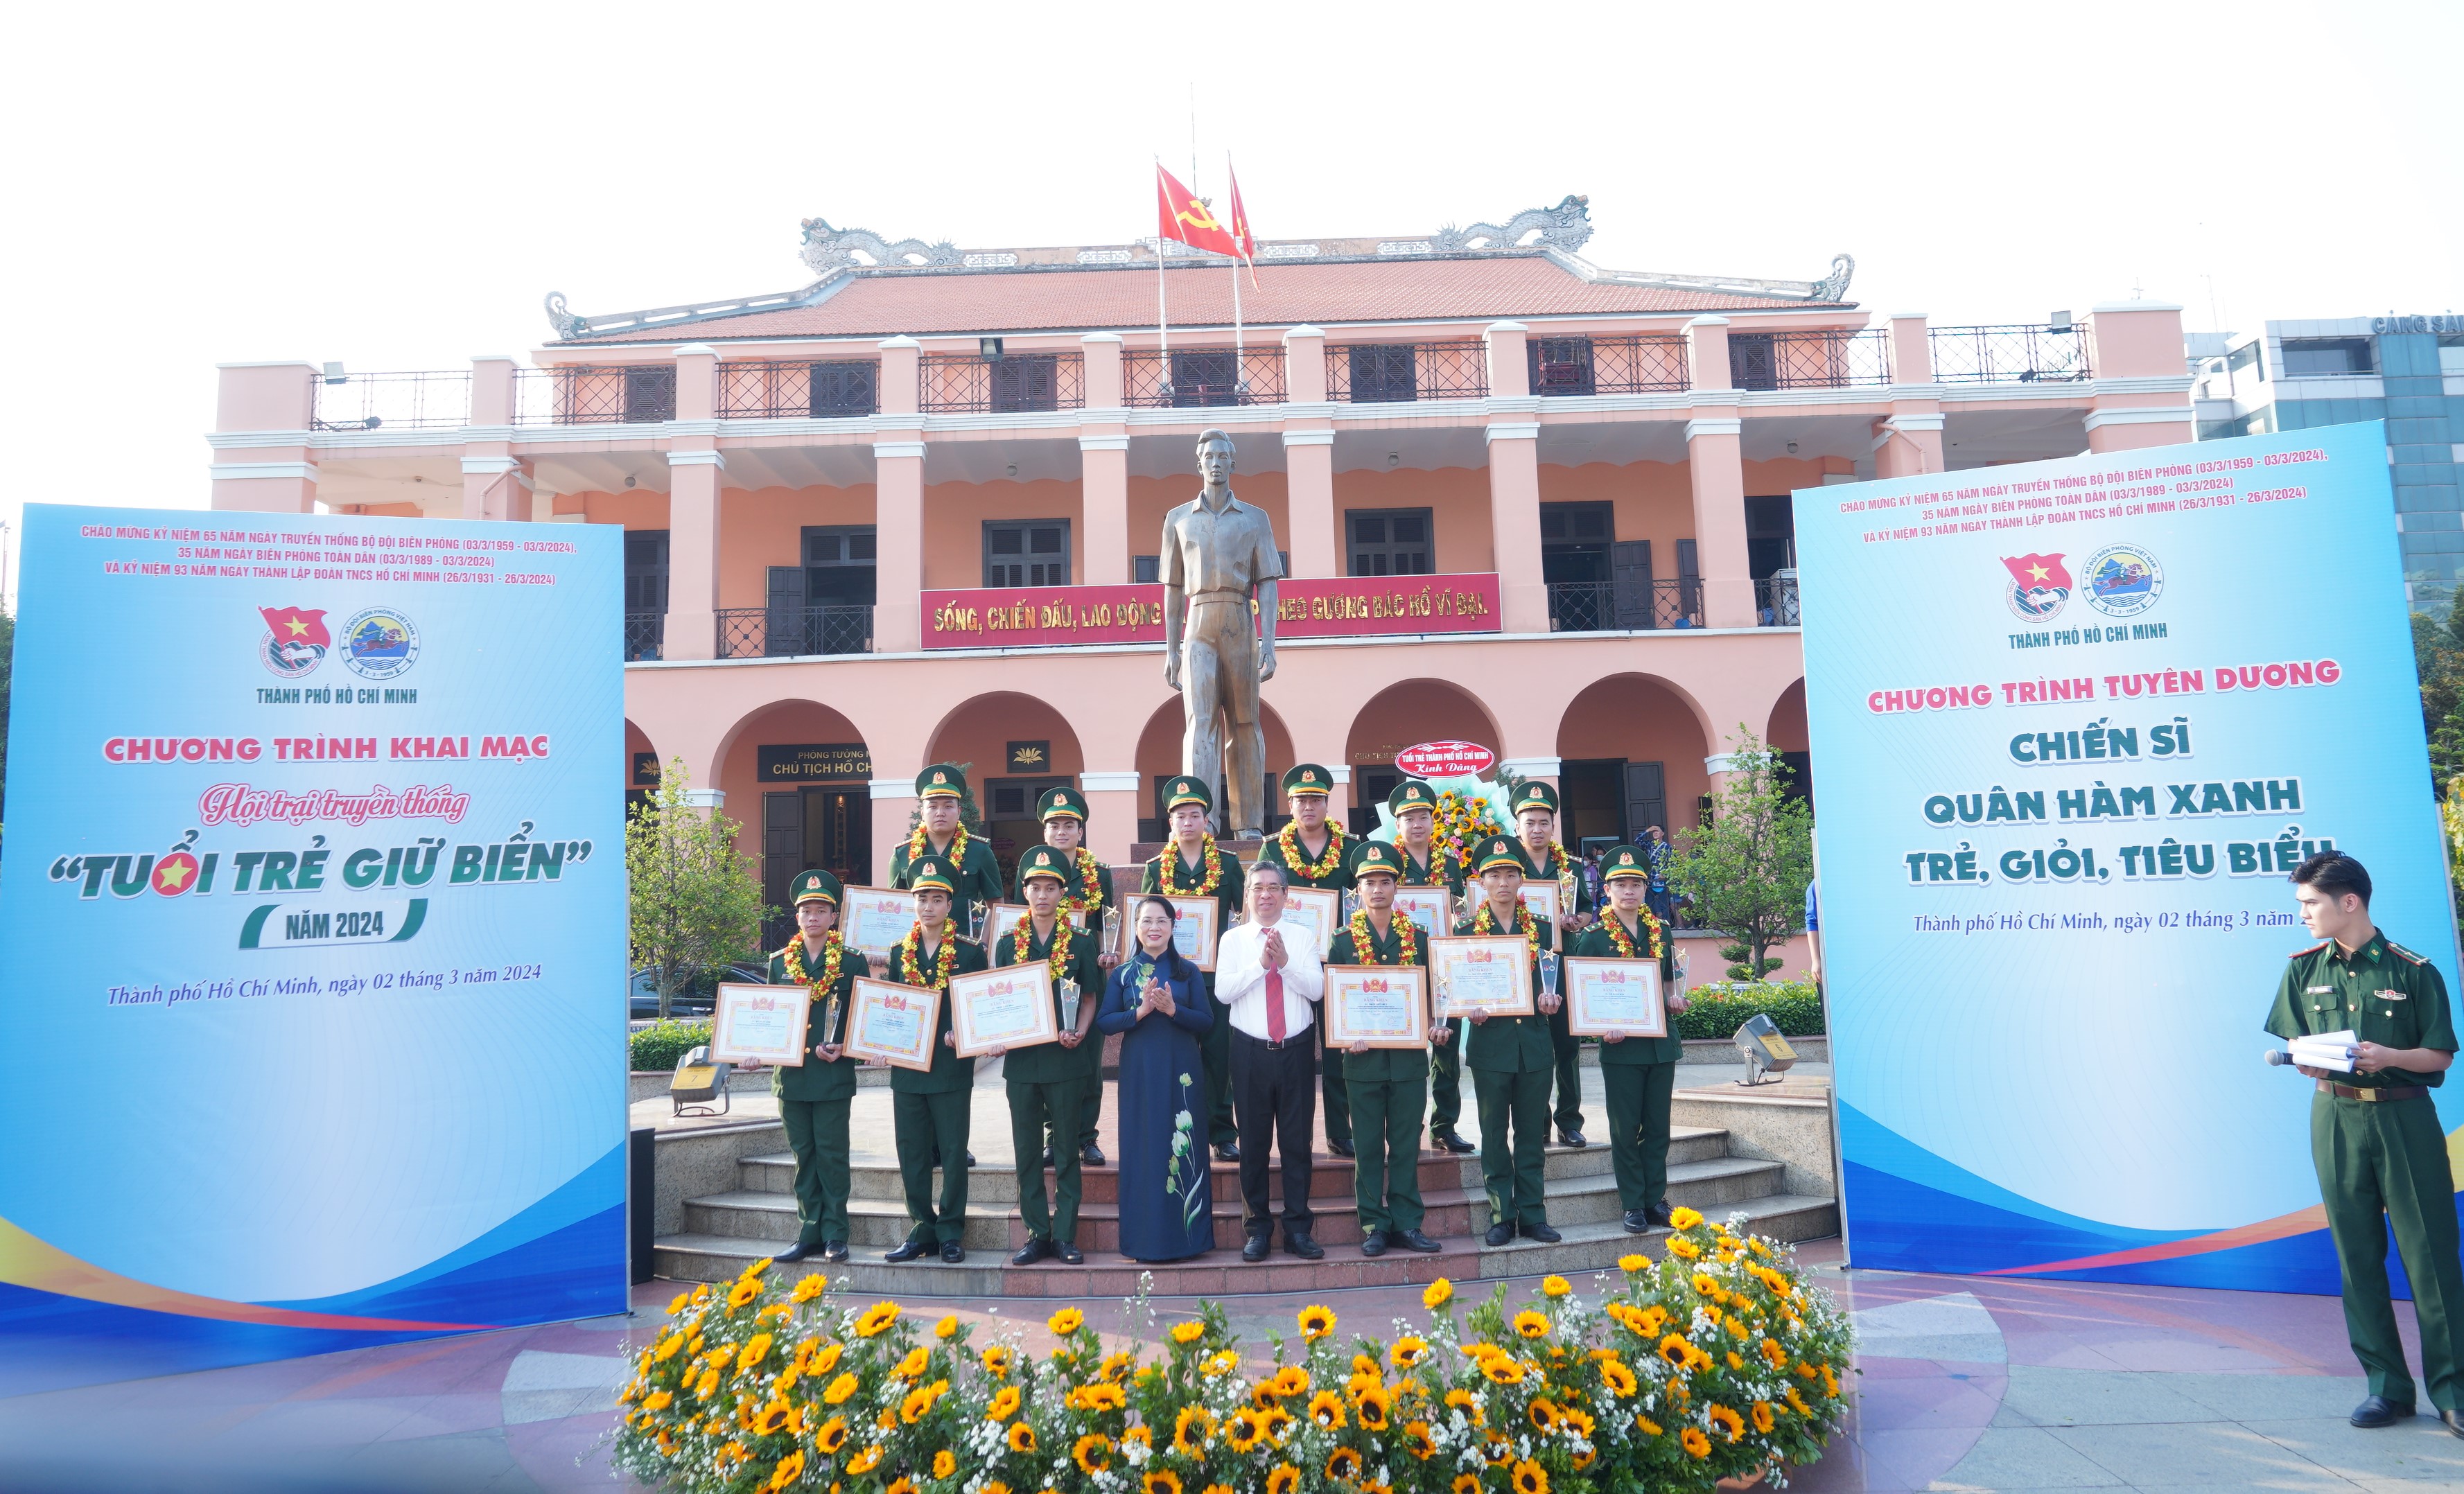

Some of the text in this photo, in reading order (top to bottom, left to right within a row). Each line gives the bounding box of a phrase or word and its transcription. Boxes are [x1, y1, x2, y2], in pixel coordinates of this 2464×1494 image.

[1840, 500, 1866, 512] CHÀO
[1898, 494, 1911, 506] KỶ
[1914, 491, 1940, 506] NIỆM
[1941, 491, 1955, 502] 65
[1955, 487, 1980, 500] NĂM
[1982, 484, 2009, 498] NGÀY
[2052, 475, 2088, 489] THỐNG
[2089, 472, 2105, 487] BỘ
[2106, 471, 2126, 486] ĐỘI
[2127, 468, 2153, 482] BIÊN
[2154, 463, 2193, 477] PHÒNG
[2195, 457, 2254, 473] (03/3/1959
[1922, 477, 2234, 520] 35 NĂM NGÀY BIÊN PHÒNG TOÀN DÂN (03/3/1989 03/3/2024)
[1863, 487, 2307, 543] VÀ KỶ NIỆM 93 NĂM NGÀY THÀNH LẬP ĐOÀN TNCS HỒ CHÍ MINH (26/3/1931 26/3/2024)
[81, 525, 112, 538] CHÀO
[153, 528, 168, 539] KỶ
[171, 528, 200, 543] NIỆM
[202, 531, 217, 541] 65
[219, 530, 246, 543] NĂM
[248, 531, 277, 543] NGÀY
[324, 533, 359, 547] THỐNG
[360, 534, 376, 549] BỘ
[378, 535, 396, 550] ĐỘI
[398, 536, 423, 548] BIÊN
[424, 537, 460, 550] PHÒNG
[462, 539, 515, 552] (03/3/1959
[177, 546, 495, 567] 35 NĂM NGÀY BIÊN PHÒNG TOÀN DÂN (03/3/1989 03/3/2024)
[934, 600, 983, 635] SỐNG,
[987, 599, 1036, 631] CHIẾN
[1040, 597, 1077, 633] ĐẤU,
[1081, 604, 1111, 627] LAO
[1117, 597, 1162, 632] ĐỘNG
[1277, 597, 1307, 621] HEO
[1312, 592, 1368, 620] GƯƠNG
[1373, 589, 1405, 618] BÁC
[1408, 585, 1431, 617] HỒ
[1435, 587, 1452, 616] VĨ
[1456, 592, 1488, 621] ĐẠI.
[2009, 623, 2167, 649] THÀNH PHỐ HỒ CHÍ MINH
[257, 684, 417, 703] THÀNH PHỐ HỒ CHÍ MINH
[1869, 661, 2339, 711] CHƯƠNG TRÌNH TUYÊN DƯƠNG
[105, 733, 546, 761] CHƯƠNG TRÌNH KHAI MẠC
[798, 750, 830, 759] PHÒNG
[832, 749, 864, 759] TƯỜNG
[1402, 752, 1414, 763] TUỔI
[1415, 753, 1425, 762] TRẺ
[1426, 753, 1443, 762] THÀNH
[1444, 750, 1455, 761] PHỐ
[1456, 750, 1463, 760] HỒ
[1464, 750, 1474, 760] CHÍ
[1474, 751, 1489, 759] MINH
[2011, 717, 2190, 762] CHIẾN SĨ
[773, 759, 872, 776] CHỦ TỊCH HỒ CH
[201, 785, 468, 825] Hội trại truyền thống
[1925, 780, 2300, 823] QUÂN HÀM XANH
[234, 835, 330, 891] TRẺ
[343, 838, 446, 888] GIỮ
[1906, 842, 1989, 882] TRẺ,
[2000, 838, 2108, 879] GIỎI,
[2120, 838, 2214, 875] TIÊU
[286, 910, 383, 940] NĂM 2024
[1914, 915, 1959, 931] Thành
[1966, 912, 1998, 935] phố
[2001, 911, 2022, 929] Hồ
[2028, 913, 2056, 929] Chí
[2061, 912, 2107, 931] Minh,
[2115, 912, 2152, 933] ngày
[2159, 913, 2178, 927] 02
[2186, 911, 2233, 931] tháng
[2239, 911, 2248, 926] 3
[2257, 911, 2293, 925] năm
[109, 965, 541, 1005] Thành phố Hồ Chí Minh, ngày 02 tháng 3 năm 2024
